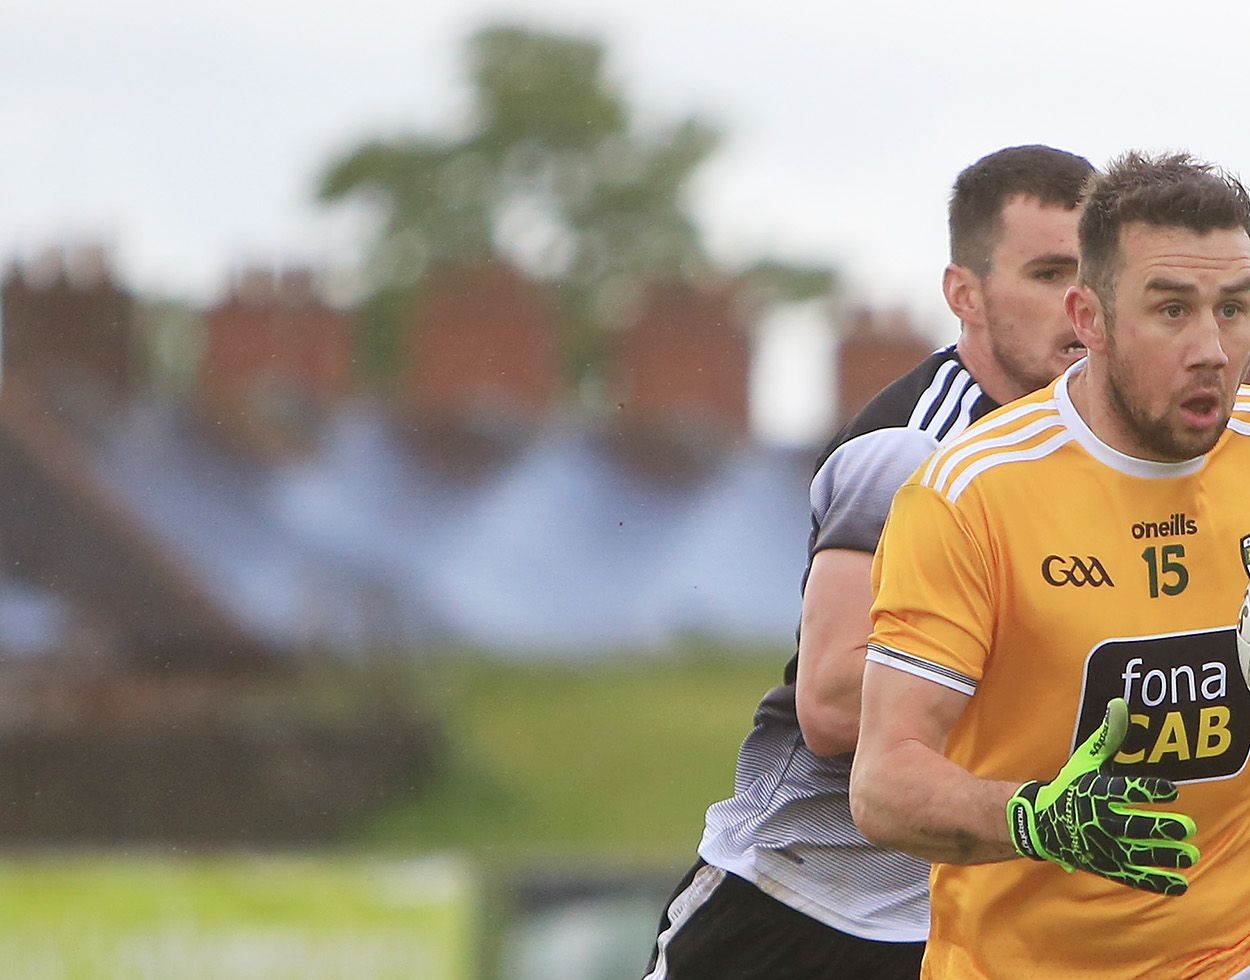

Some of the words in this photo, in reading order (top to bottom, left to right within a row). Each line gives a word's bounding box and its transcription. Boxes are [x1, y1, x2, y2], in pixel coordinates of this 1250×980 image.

[1141, 544, 1189, 598] 15
[1121, 657, 1228, 707] fona
[1113, 705, 1232, 765] CAB
